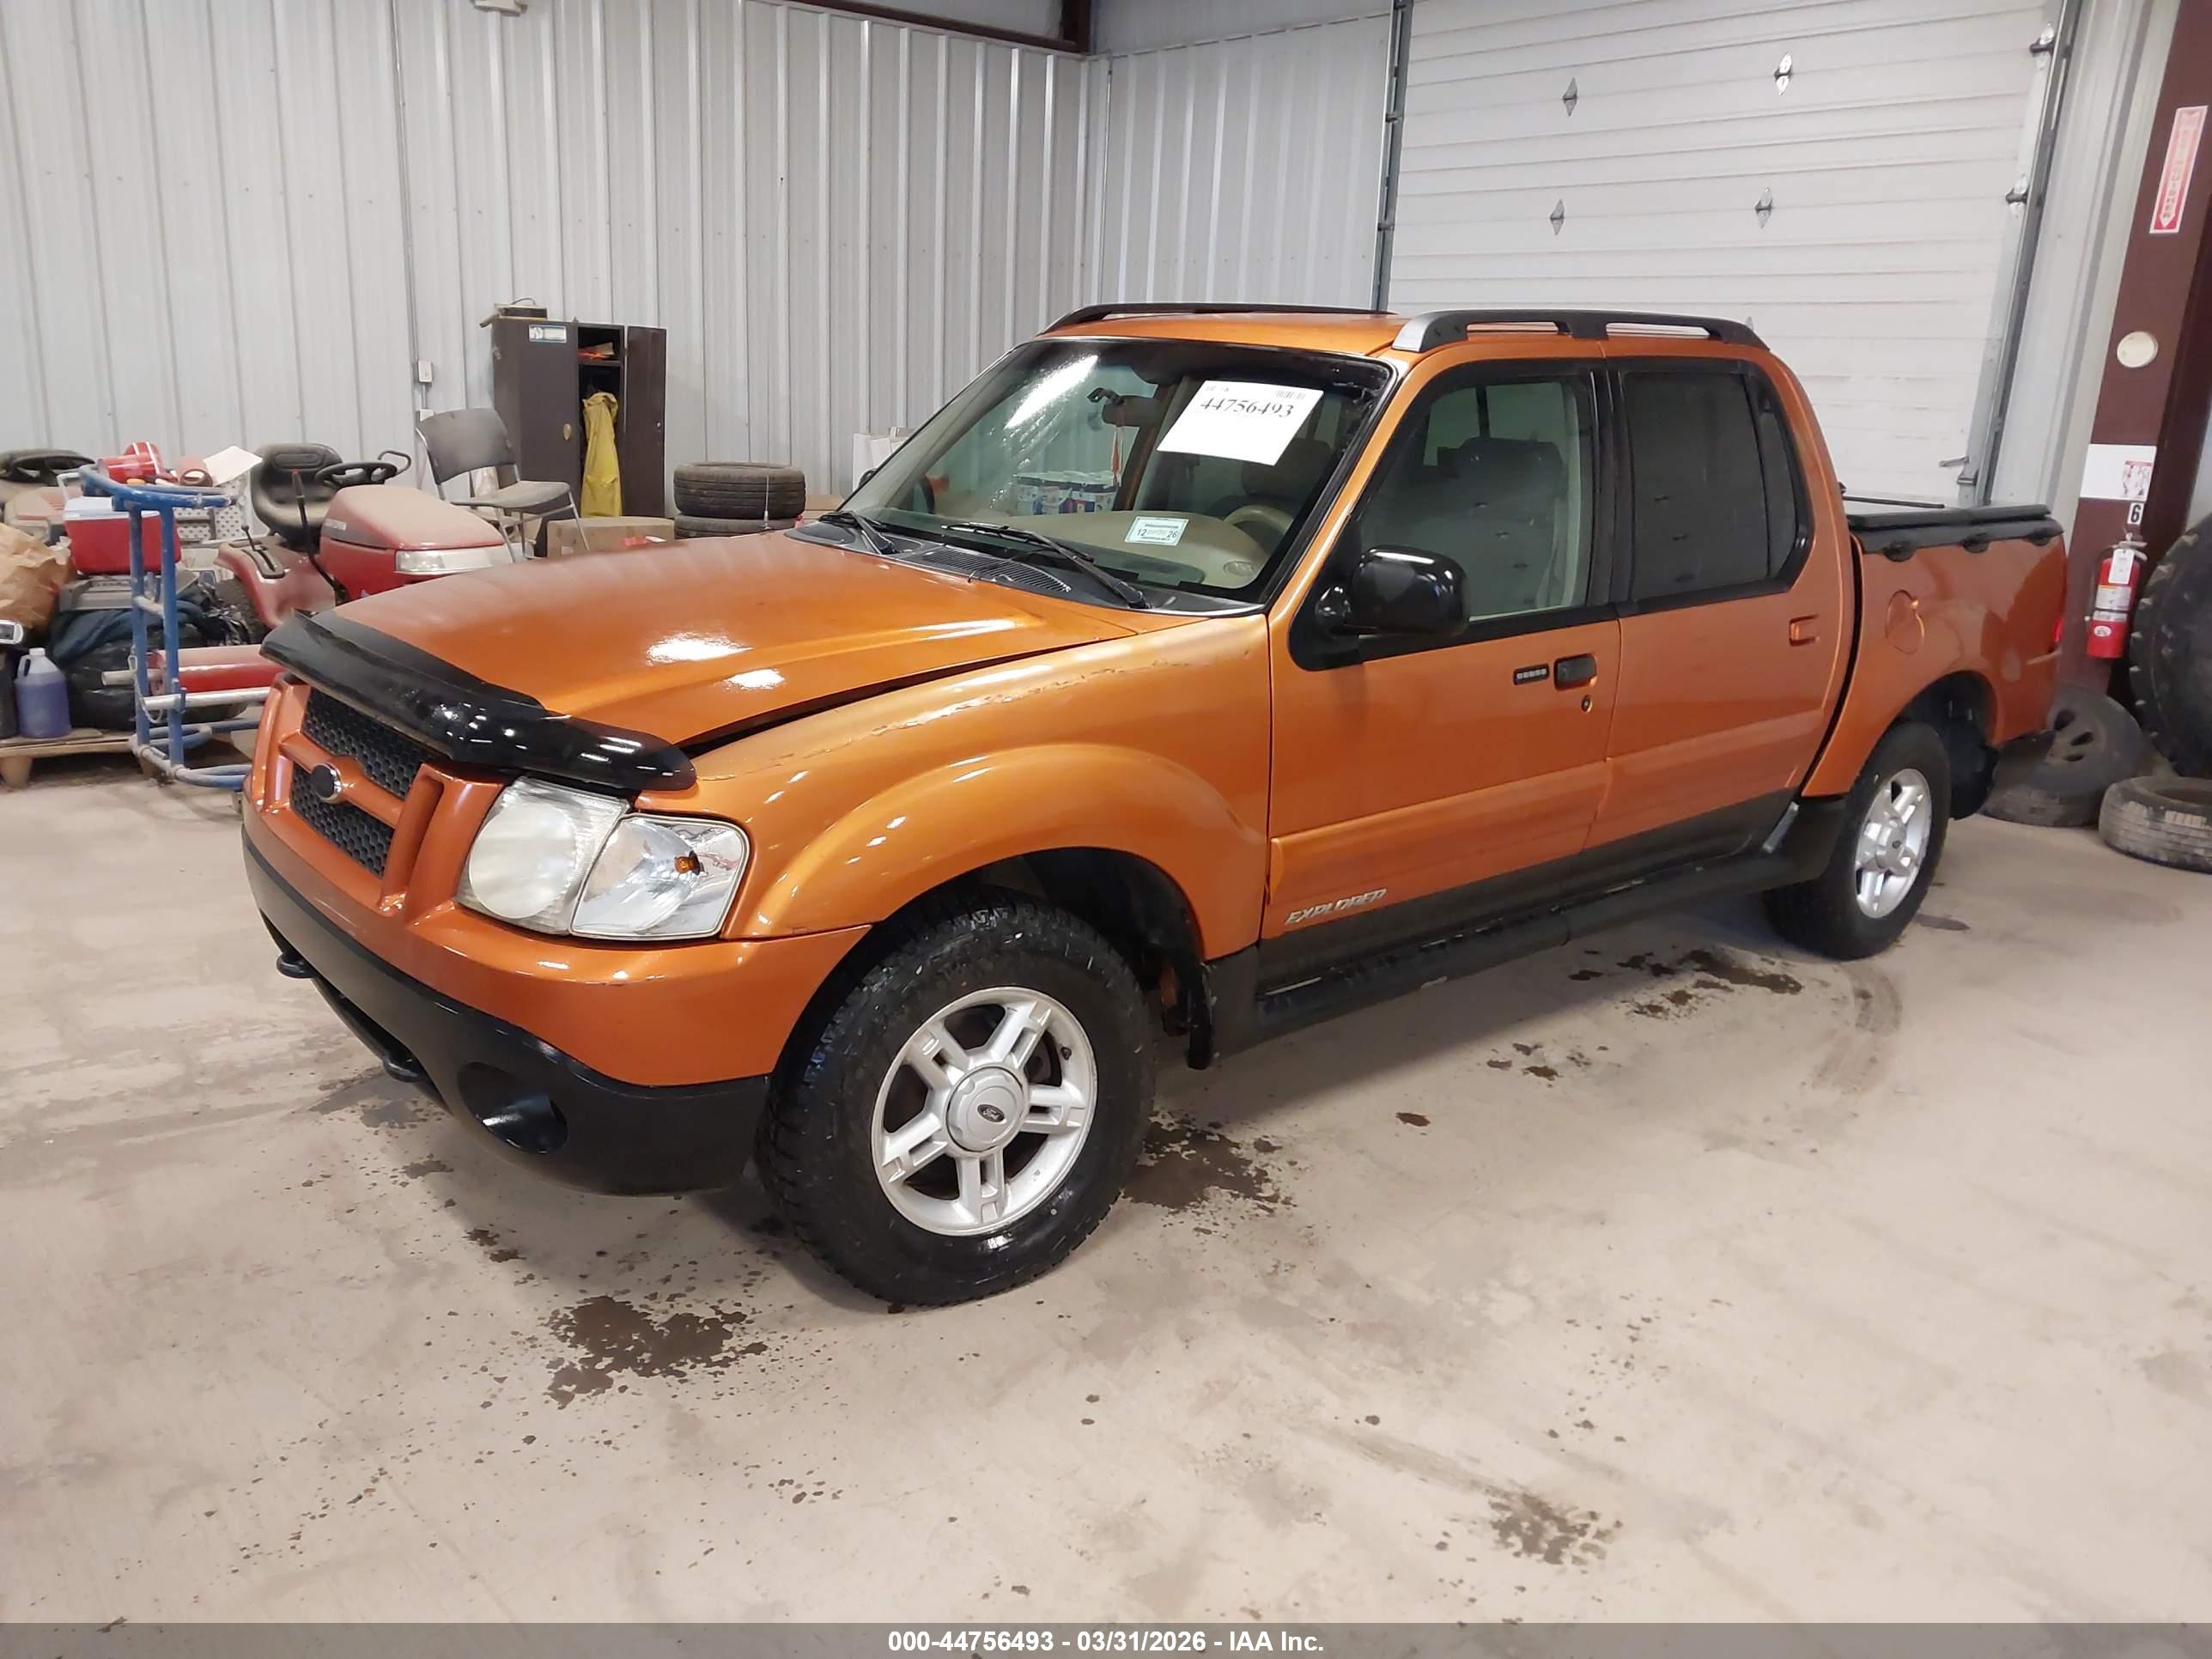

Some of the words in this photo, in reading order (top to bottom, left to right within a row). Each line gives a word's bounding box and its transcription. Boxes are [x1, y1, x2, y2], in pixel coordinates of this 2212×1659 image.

[1200, 397, 1294, 417] 44756493
[2130, 504, 2142, 523] 6
[1137, 528, 1147, 537] 12
[1167, 530, 1178, 538] 26
[1284, 888, 1388, 926] EXPLORER
